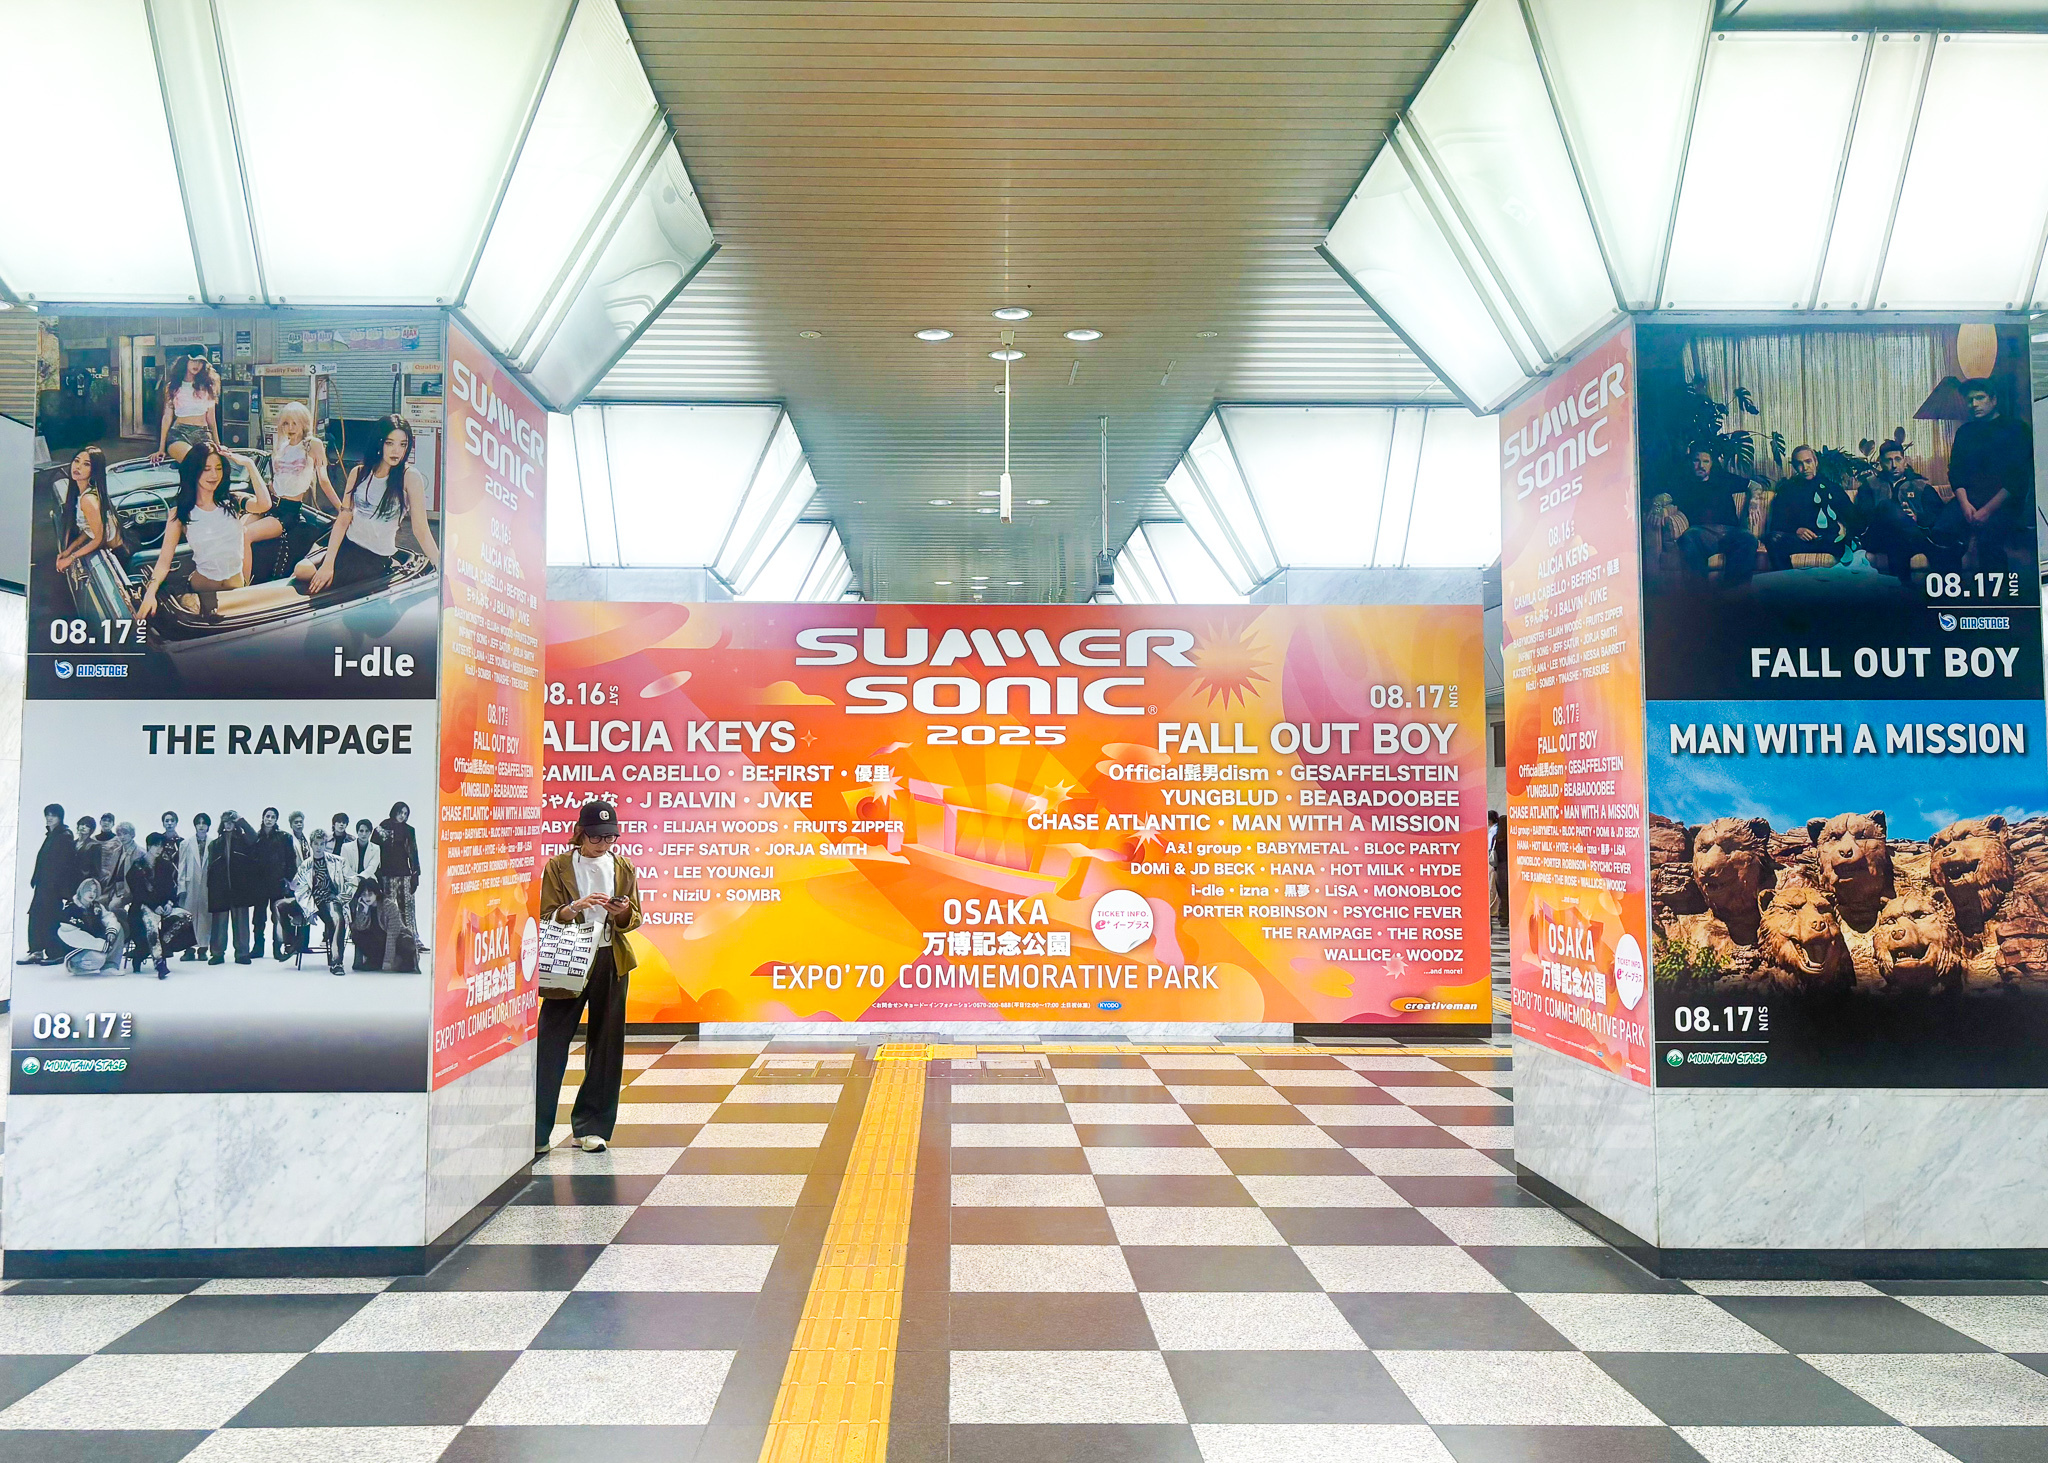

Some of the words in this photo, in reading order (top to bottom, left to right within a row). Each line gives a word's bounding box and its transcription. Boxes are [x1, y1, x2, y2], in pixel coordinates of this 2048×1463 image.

[309, 364, 317, 374] 3
[452, 359, 544, 468] SUMMER
[1504, 362, 1626, 470] SUMMER
[465, 416, 534, 499] SONIC
[1517, 416, 1608, 501] SONIC
[485, 474, 518, 511] 2025
[1540, 476, 1583, 513] 2025
[1549, 520, 1571, 547] 08.16
[481, 542, 502, 571] ALICIA
[504, 557, 520, 580] KEYS
[1537, 556, 1564, 580] ALICIA
[1565, 542, 1589, 566] KEYS
[1926, 573, 2005, 598] 08.17
[2008, 572, 2019, 597] SUN
[50, 619, 132, 645] 08.17
[136, 619, 147, 643] SUN
[1960, 617, 1978, 630] AIR
[1978, 617, 2010, 630] STAGE
[795, 627, 1196, 667] SUMMER
[76, 664, 95, 677] AIR
[95, 664, 128, 677] STAGE
[334, 646, 414, 677] i-dle
[1751, 648, 1841, 678] FALL
[1855, 647, 1931, 679] OUT
[1945, 648, 2020, 678] BOY
[544, 682, 606, 706] 8.16
[609, 685, 619, 706] SAT
[845, 677, 1145, 715] SONIC
[1370, 684, 1445, 709] 08.17
[1448, 684, 1459, 708] SUN
[487, 703, 505, 726] 08.17
[1553, 703, 1575, 727] 08.17
[142, 724, 215, 755] THE
[228, 724, 412, 755] RAMPAGE
[473, 730, 490, 752] FALL
[491, 733, 506, 753] OUT
[506, 734, 519, 755] BOY
[543, 720, 673, 753] ALICIA
[687, 720, 796, 754] KEYS
[926, 725, 1066, 746] 2025
[1157, 723, 1258, 755] FALL
[1270, 722, 1359, 755] OUT
[1374, 723, 1458, 756] BOY
[1537, 734, 1557, 755] FALL
[1558, 732, 1578, 753] OUT
[1579, 729, 1598, 750] BOY
[1670, 724, 1745, 755] MAN
[1755, 723, 1844, 755] WITH
[1852, 724, 1877, 754] A
[1885, 723, 2026, 755] MISSION
[622, 764, 721, 782] CABELLO
[742, 765, 834, 782] BE:FIRST
[854, 764, 890, 783] 優里
[1109, 763, 1269, 782] Official髭男dism
[1290, 764, 1459, 782] GESAFFELSTEIN
[1568, 755, 1624, 775] GESAFFELSTEIN
[640, 791, 652, 808] J
[658, 791, 736, 808] BALVIN
[757, 791, 813, 808] JVKE
[1161, 789, 1279, 806] YUNGBLUD
[1300, 790, 1460, 807] BEABADOOBEE
[1526, 784, 1560, 799] YUNGBLUD
[1563, 780, 1616, 797] BEABADOOBEE
[1027, 813, 1099, 831] CHASE
[1105, 813, 1211, 831] ATLANTIC
[1232, 814, 1281, 831] MAN
[1288, 815, 1343, 831] WITH
[1349, 815, 1365, 831] A
[1371, 815, 1460, 832] MISSION
[1509, 805, 1528, 819] CHASE
[1529, 805, 1560, 819] ATLANTIC
[1563, 805, 1580, 819] MAN
[1580, 804, 1599, 818] WITH
[1600, 804, 1607, 818] A
[1607, 804, 1640, 819] MISSION
[663, 821, 717, 833] ELIJAH
[722, 821, 778, 833] WOODS
[793, 820, 847, 833] FRUITS
[851, 820, 904, 833] ZIPPER
[658, 843, 694, 856] JEFF
[699, 843, 750, 856] SATUR
[765, 843, 815, 856] JORJA
[819, 843, 867, 856] SMITH
[1165, 842, 1192, 854] Aえ!
[1196, 844, 1242, 857] group
[1256, 842, 1349, 855] BABYMETAL
[1364, 843, 1407, 855] BLOC
[1409, 843, 1461, 855] PARTY
[673, 866, 701, 879] LEE
[706, 866, 774, 879] YOUNGJI
[1130, 862, 1170, 875] DOMi
[1174, 862, 1186, 875] &
[1190, 862, 1210, 875] JD
[1214, 862, 1255, 875] BECK
[1270, 863, 1315, 876] HANA
[1330, 863, 1362, 876] HOT
[1367, 863, 1404, 876] MILK
[1419, 863, 1461, 876] HYDE
[673, 889, 710, 902] NiziU
[726, 889, 781, 902] SOMBR
[1191, 884, 1224, 897] i-dle
[1239, 884, 1269, 897] izna
[1325, 885, 1358, 897] LiSA
[1373, 885, 1462, 898] MONOBLOC
[943, 899, 1049, 925] OSAKA
[1183, 905, 1244, 918] PORTER
[1249, 906, 1328, 918] ROBINSON
[1343, 906, 1409, 919] PSYCHIC
[1413, 906, 1462, 919] FEVER
[1113, 920, 1150, 929] イープラス
[1262, 927, 1292, 939] THE
[1297, 927, 1372, 940] RAMPAGE
[1387, 928, 1419, 940] THE
[1423, 928, 1463, 940] ROSE
[474, 925, 510, 966] OSAKA
[923, 931, 1071, 958] 万博記念公園
[1548, 922, 1595, 963] OSAKA
[1324, 949, 1391, 961] WALLICE
[1406, 949, 1463, 962] WOODZ
[465, 961, 516, 1008] 万博記念公園
[898, 963, 1139, 990] COMMEMORATIVE
[1147, 964, 1218, 989] PARK
[1540, 958, 1607, 1006] 万博記念公園
[468, 994, 522, 1037] COMMEMORATIVE
[522, 988, 537, 1010] PARK
[1404, 1002, 1478, 1010] creativeman
[33, 1012, 117, 1039] 08.17
[121, 1012, 132, 1038] SUN
[1544, 996, 1618, 1038] COMMEMORATIVE
[1619, 1018, 1646, 1048] PARK
[1674, 1006, 1755, 1032] 08.17
[1758, 1006, 1769, 1032] SUN
[43, 1060, 94, 1072] MOUNTAIN
[95, 1059, 127, 1071] STAGE
[1687, 1052, 1736, 1064] MOUNTAIN
[1736, 1051, 1767, 1064] STAGE
